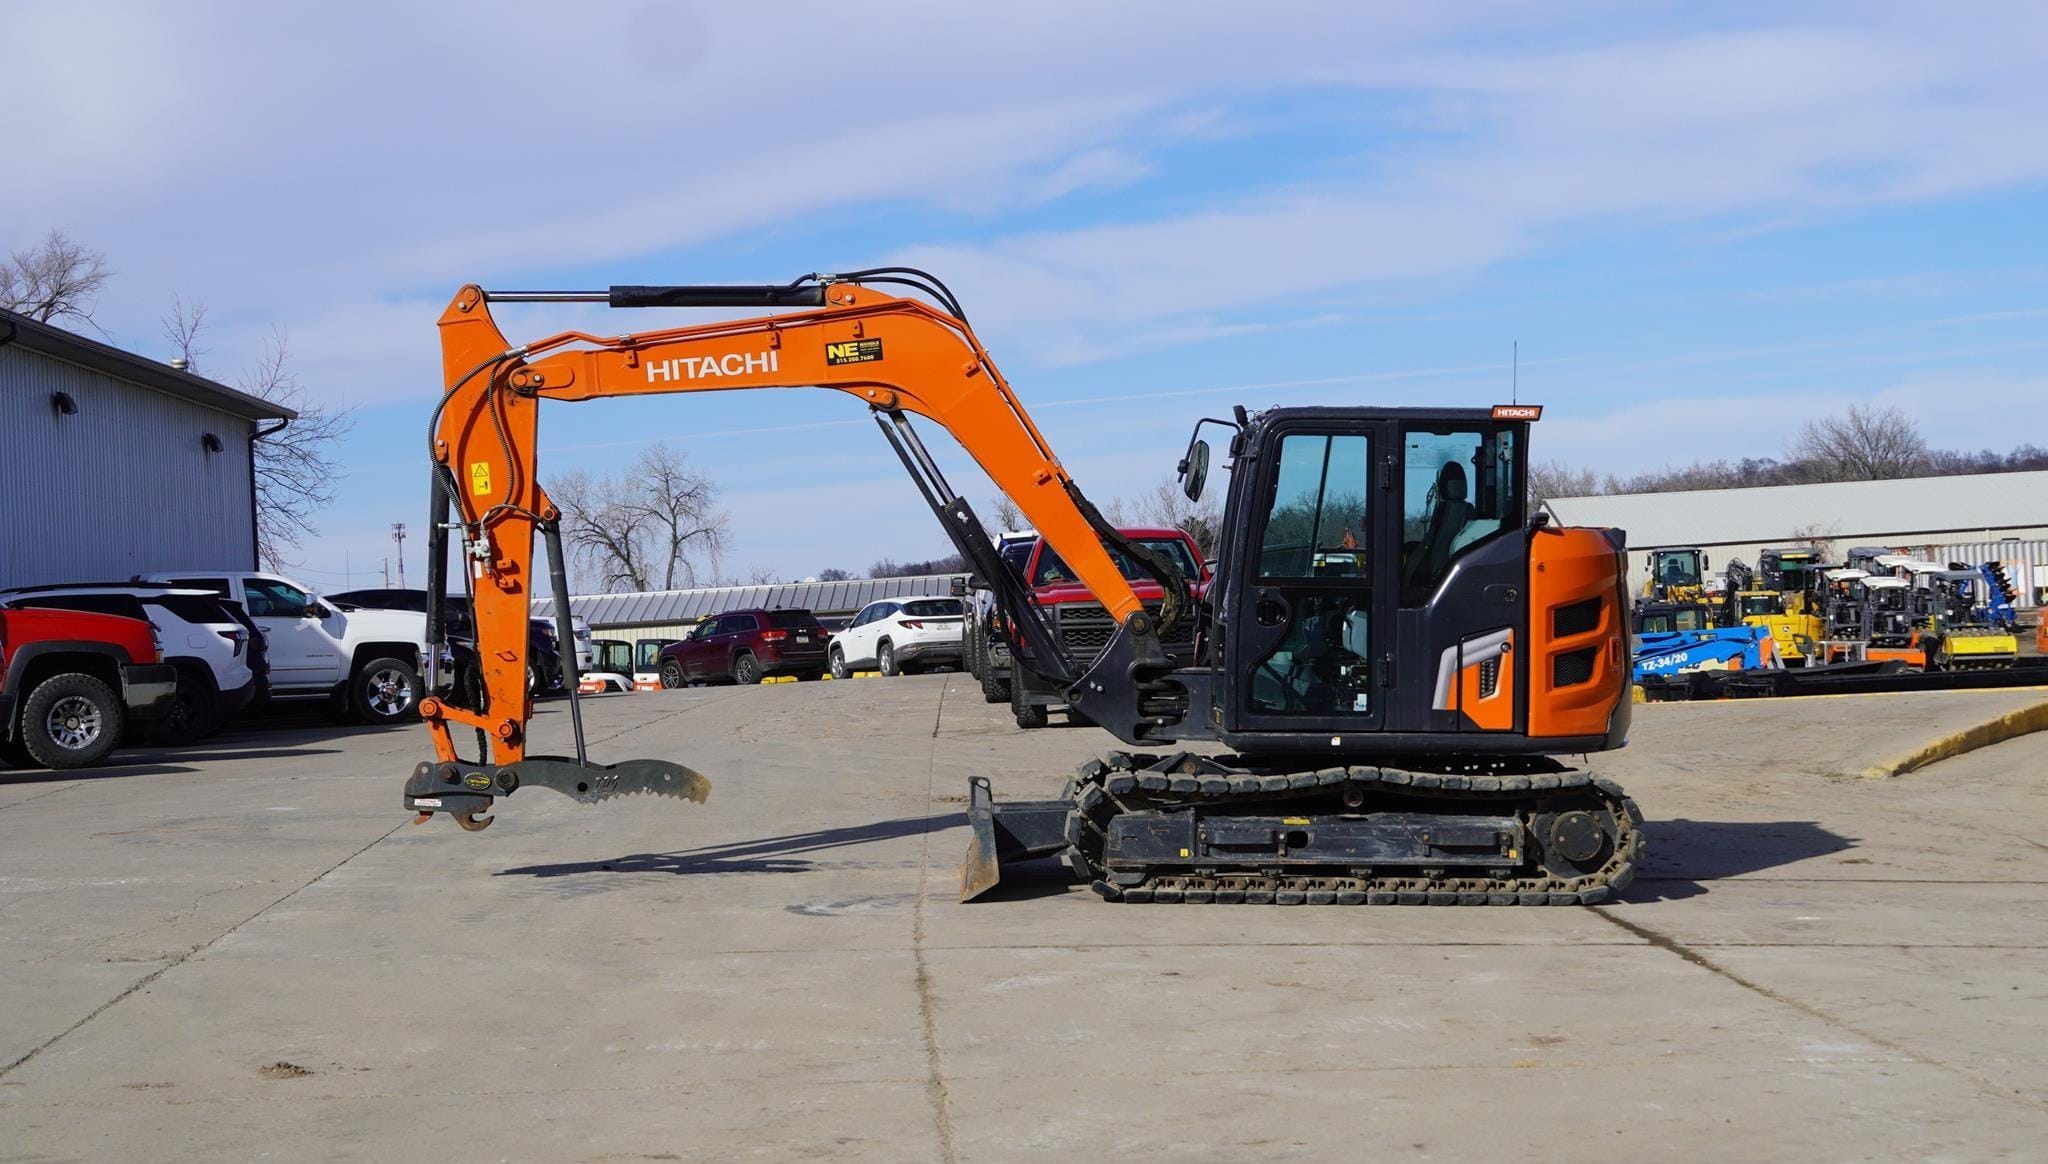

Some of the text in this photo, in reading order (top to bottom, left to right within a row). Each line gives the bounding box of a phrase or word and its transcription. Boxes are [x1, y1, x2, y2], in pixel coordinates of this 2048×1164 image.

[827, 343, 859, 359] NE
[647, 350, 778, 382] HITACHI
[1497, 409, 1536, 417] HITACHI
[1642, 652, 1688, 671] TZ-34/20
